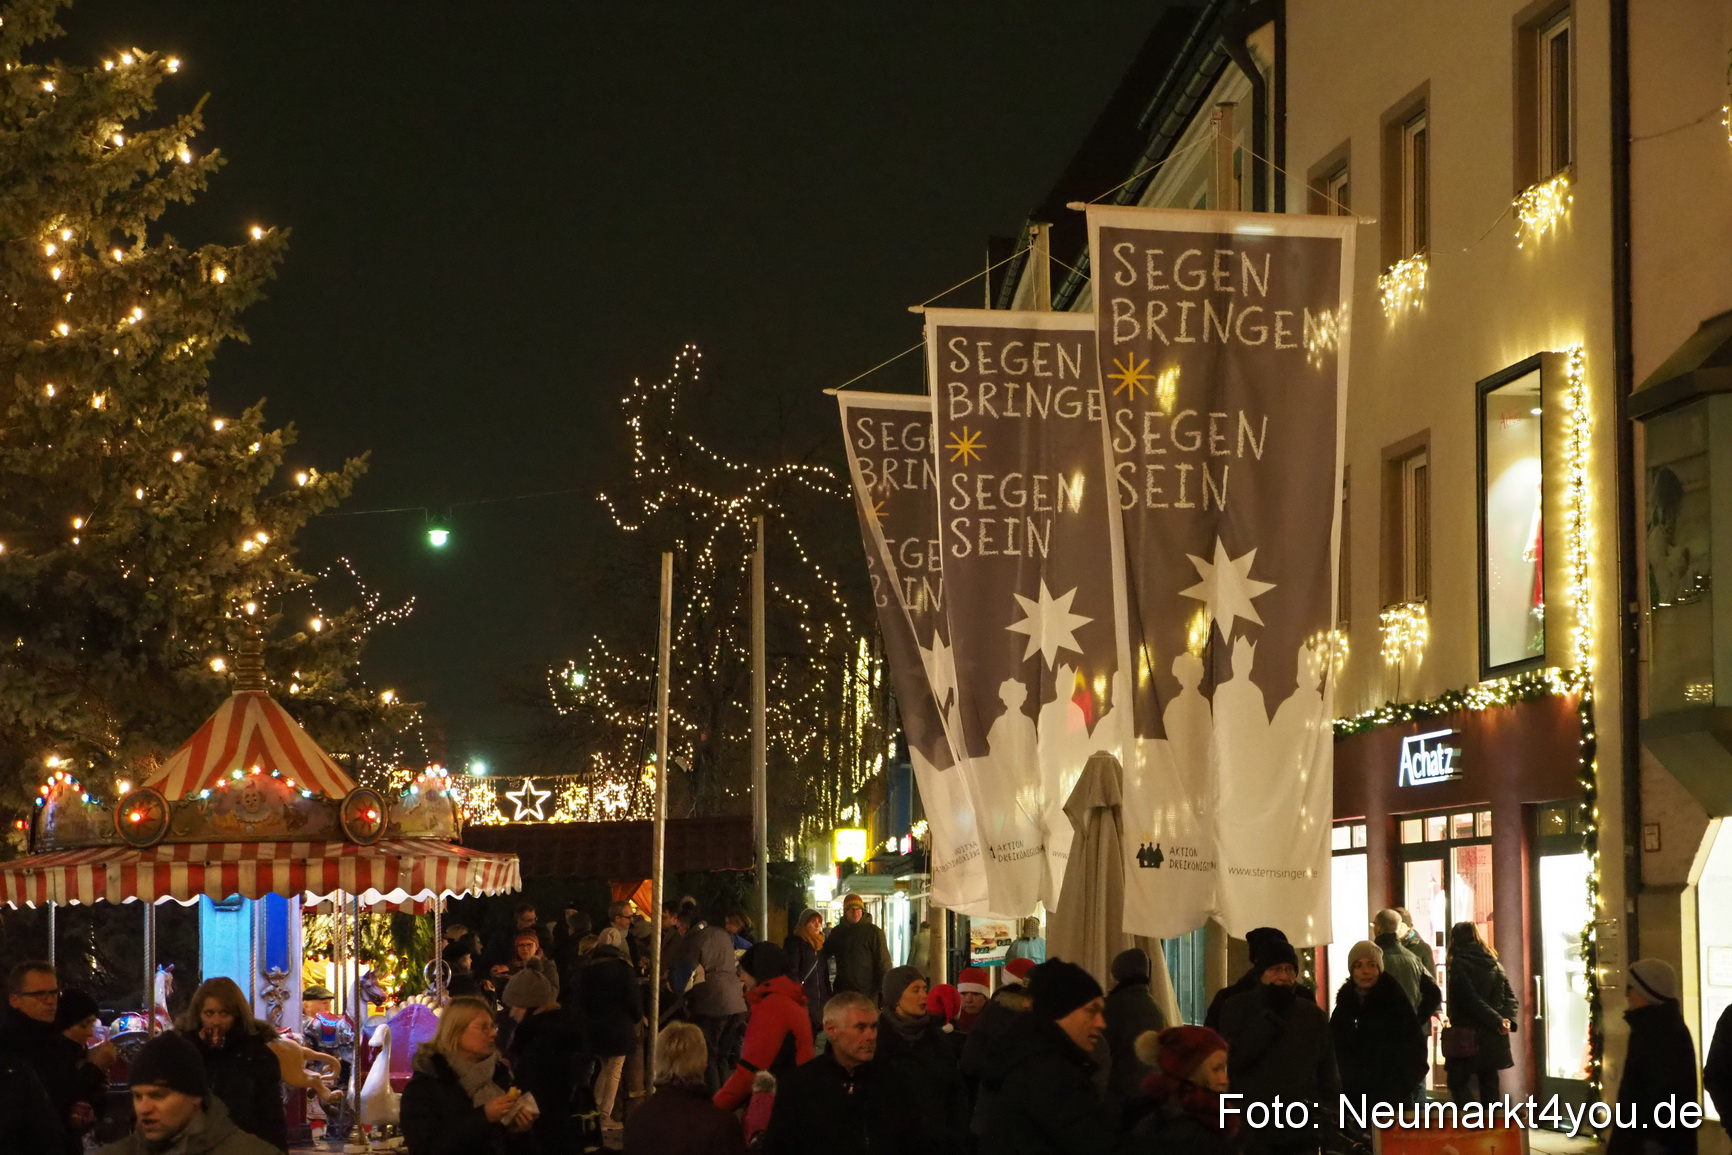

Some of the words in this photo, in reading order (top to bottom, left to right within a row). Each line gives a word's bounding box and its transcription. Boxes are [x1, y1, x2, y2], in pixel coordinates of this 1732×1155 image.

[1112, 242, 1271, 297] SEGEN
[1111, 297, 1340, 351] BRINGEN
[948, 337, 1083, 379] SEGEN
[1113, 409, 1268, 460] SEGEN
[949, 472, 1085, 514] SEGEN
[1114, 461, 1229, 512] SEIN
[950, 516, 1051, 559] SEIN
[1399, 729, 1454, 787] Achatz
[997, 840, 1024, 852] AKTION
[1169, 846, 1199, 857] AKTION
